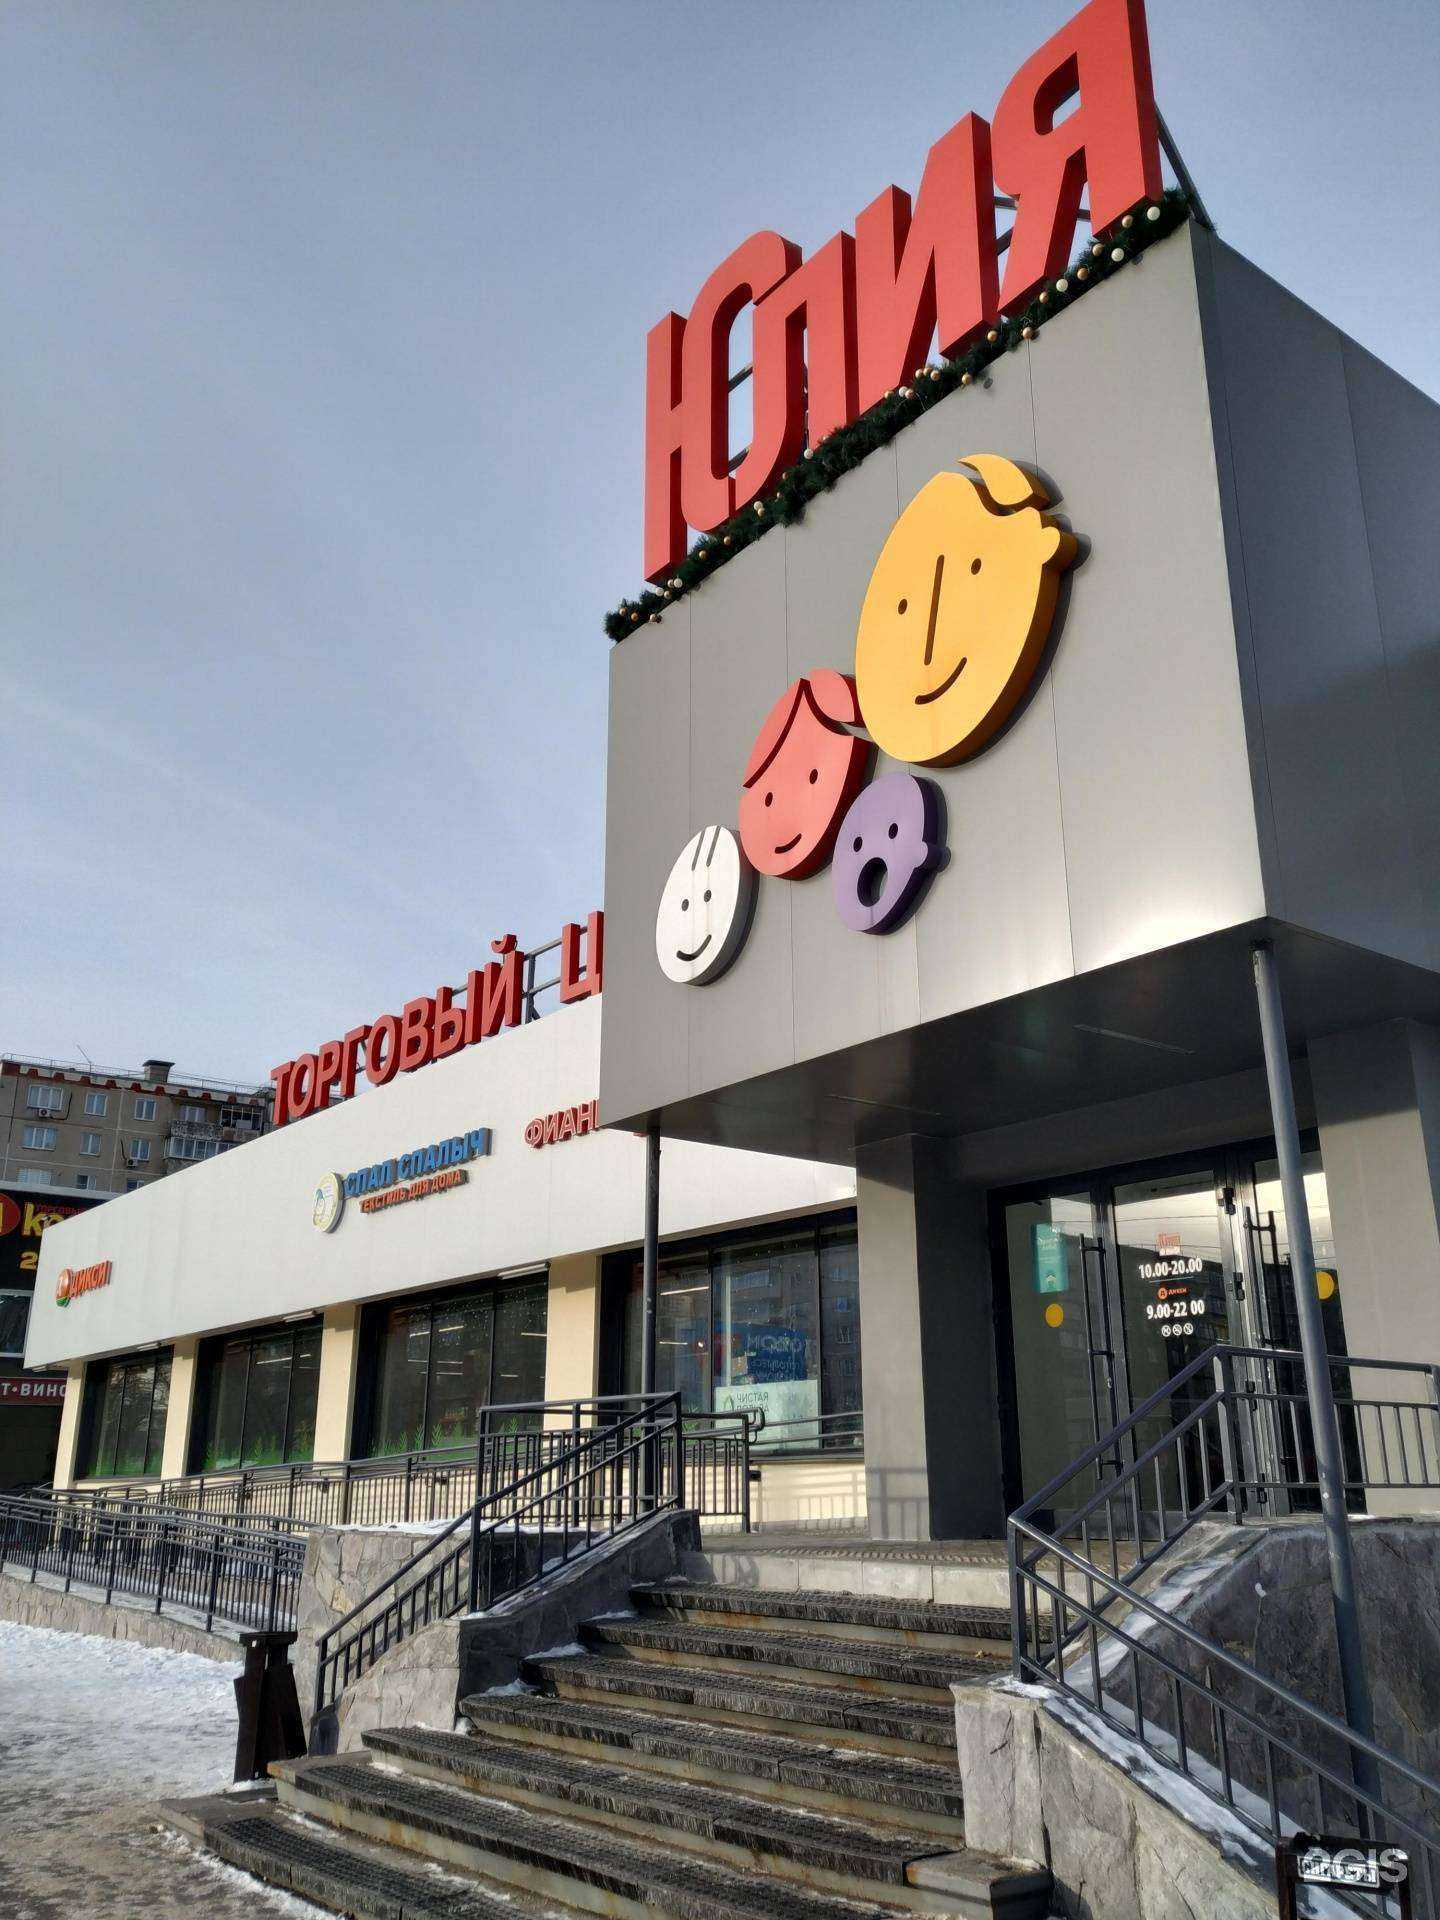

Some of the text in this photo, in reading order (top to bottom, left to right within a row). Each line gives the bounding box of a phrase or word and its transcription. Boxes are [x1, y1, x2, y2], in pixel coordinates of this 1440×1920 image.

[645, 0, 1164, 585] ЮЛИЯ
[270, 911, 604, 1126] ТОРГОВЫЙ Ц
[343, 1127, 493, 1198] СПАЛ СПАЛЫЧ
[359, 1169, 469, 1213] ТЕКСТИЛЬ ДЛЯ ДОМА
[70, 1260, 112, 1297] ДИКСИ
[1139, 1256, 1203, 1279] 10.00-20.00
[736, 1391, 769, 1404] ЧИСТАЯ
